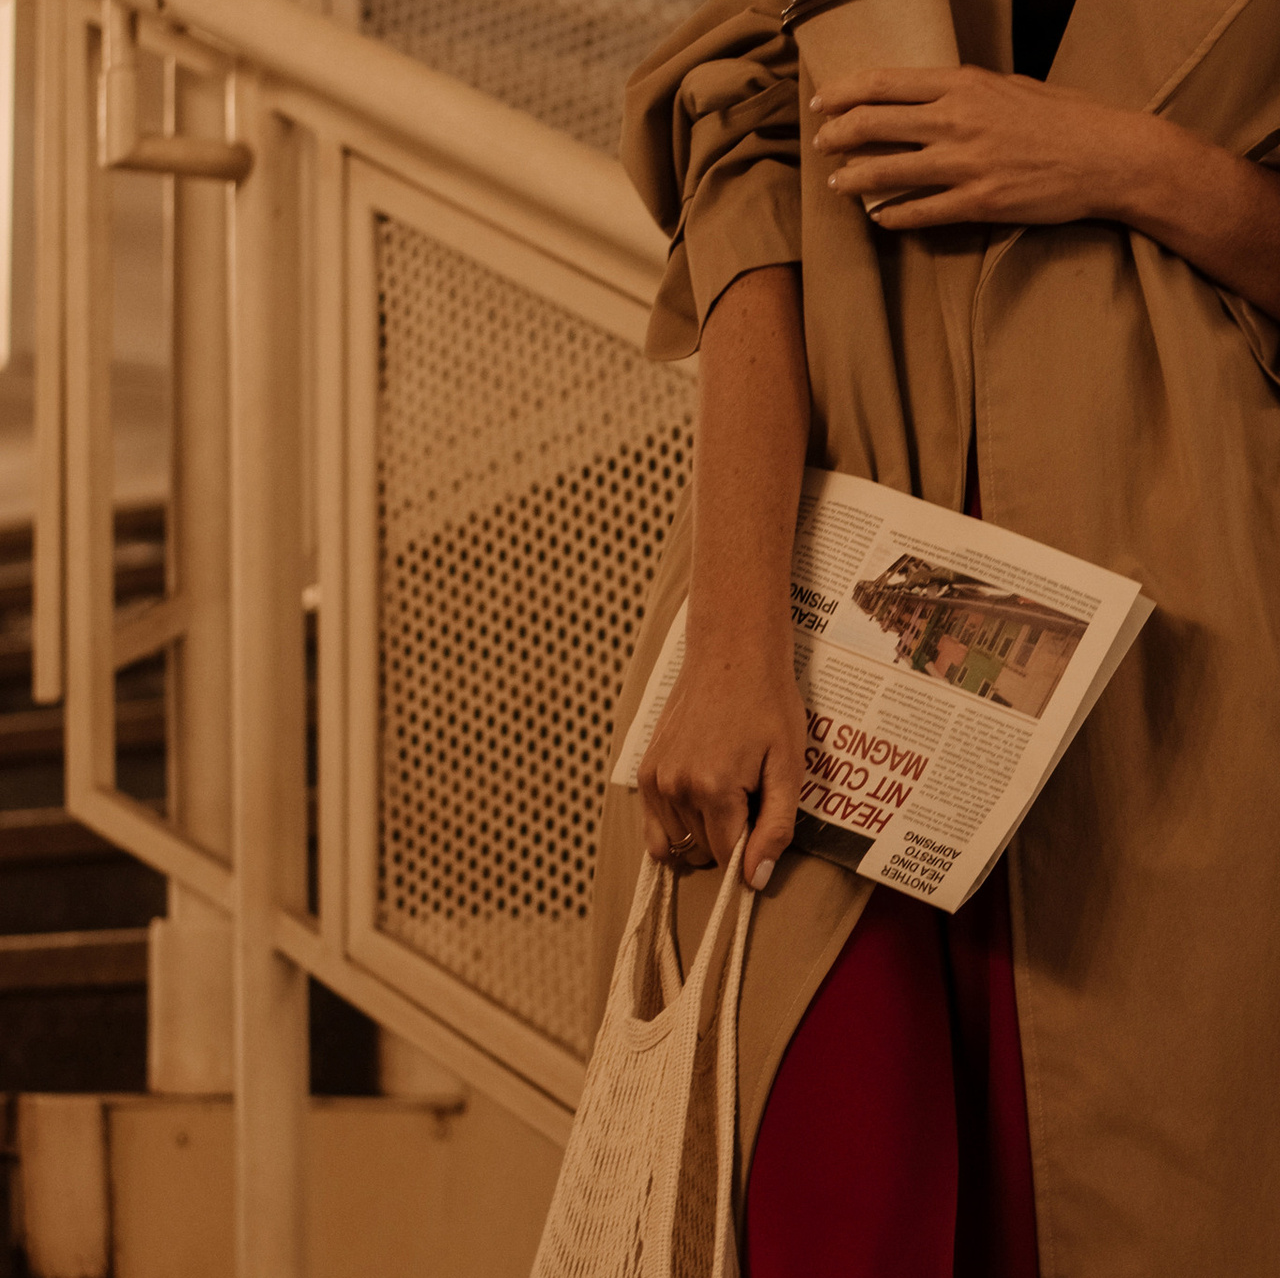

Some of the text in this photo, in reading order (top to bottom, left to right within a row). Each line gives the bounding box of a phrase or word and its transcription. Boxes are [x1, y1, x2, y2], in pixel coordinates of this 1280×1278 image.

[805, 708, 834, 743] DI
[830, 722, 930, 781] MAGNIS
[864, 775, 913, 809] NIT
[902, 829, 962, 860] ADIPISING
[903, 844, 953, 872] DURSTO
[879, 864, 938, 895] ANOTHER
[888, 853, 945, 884] HEA DING
